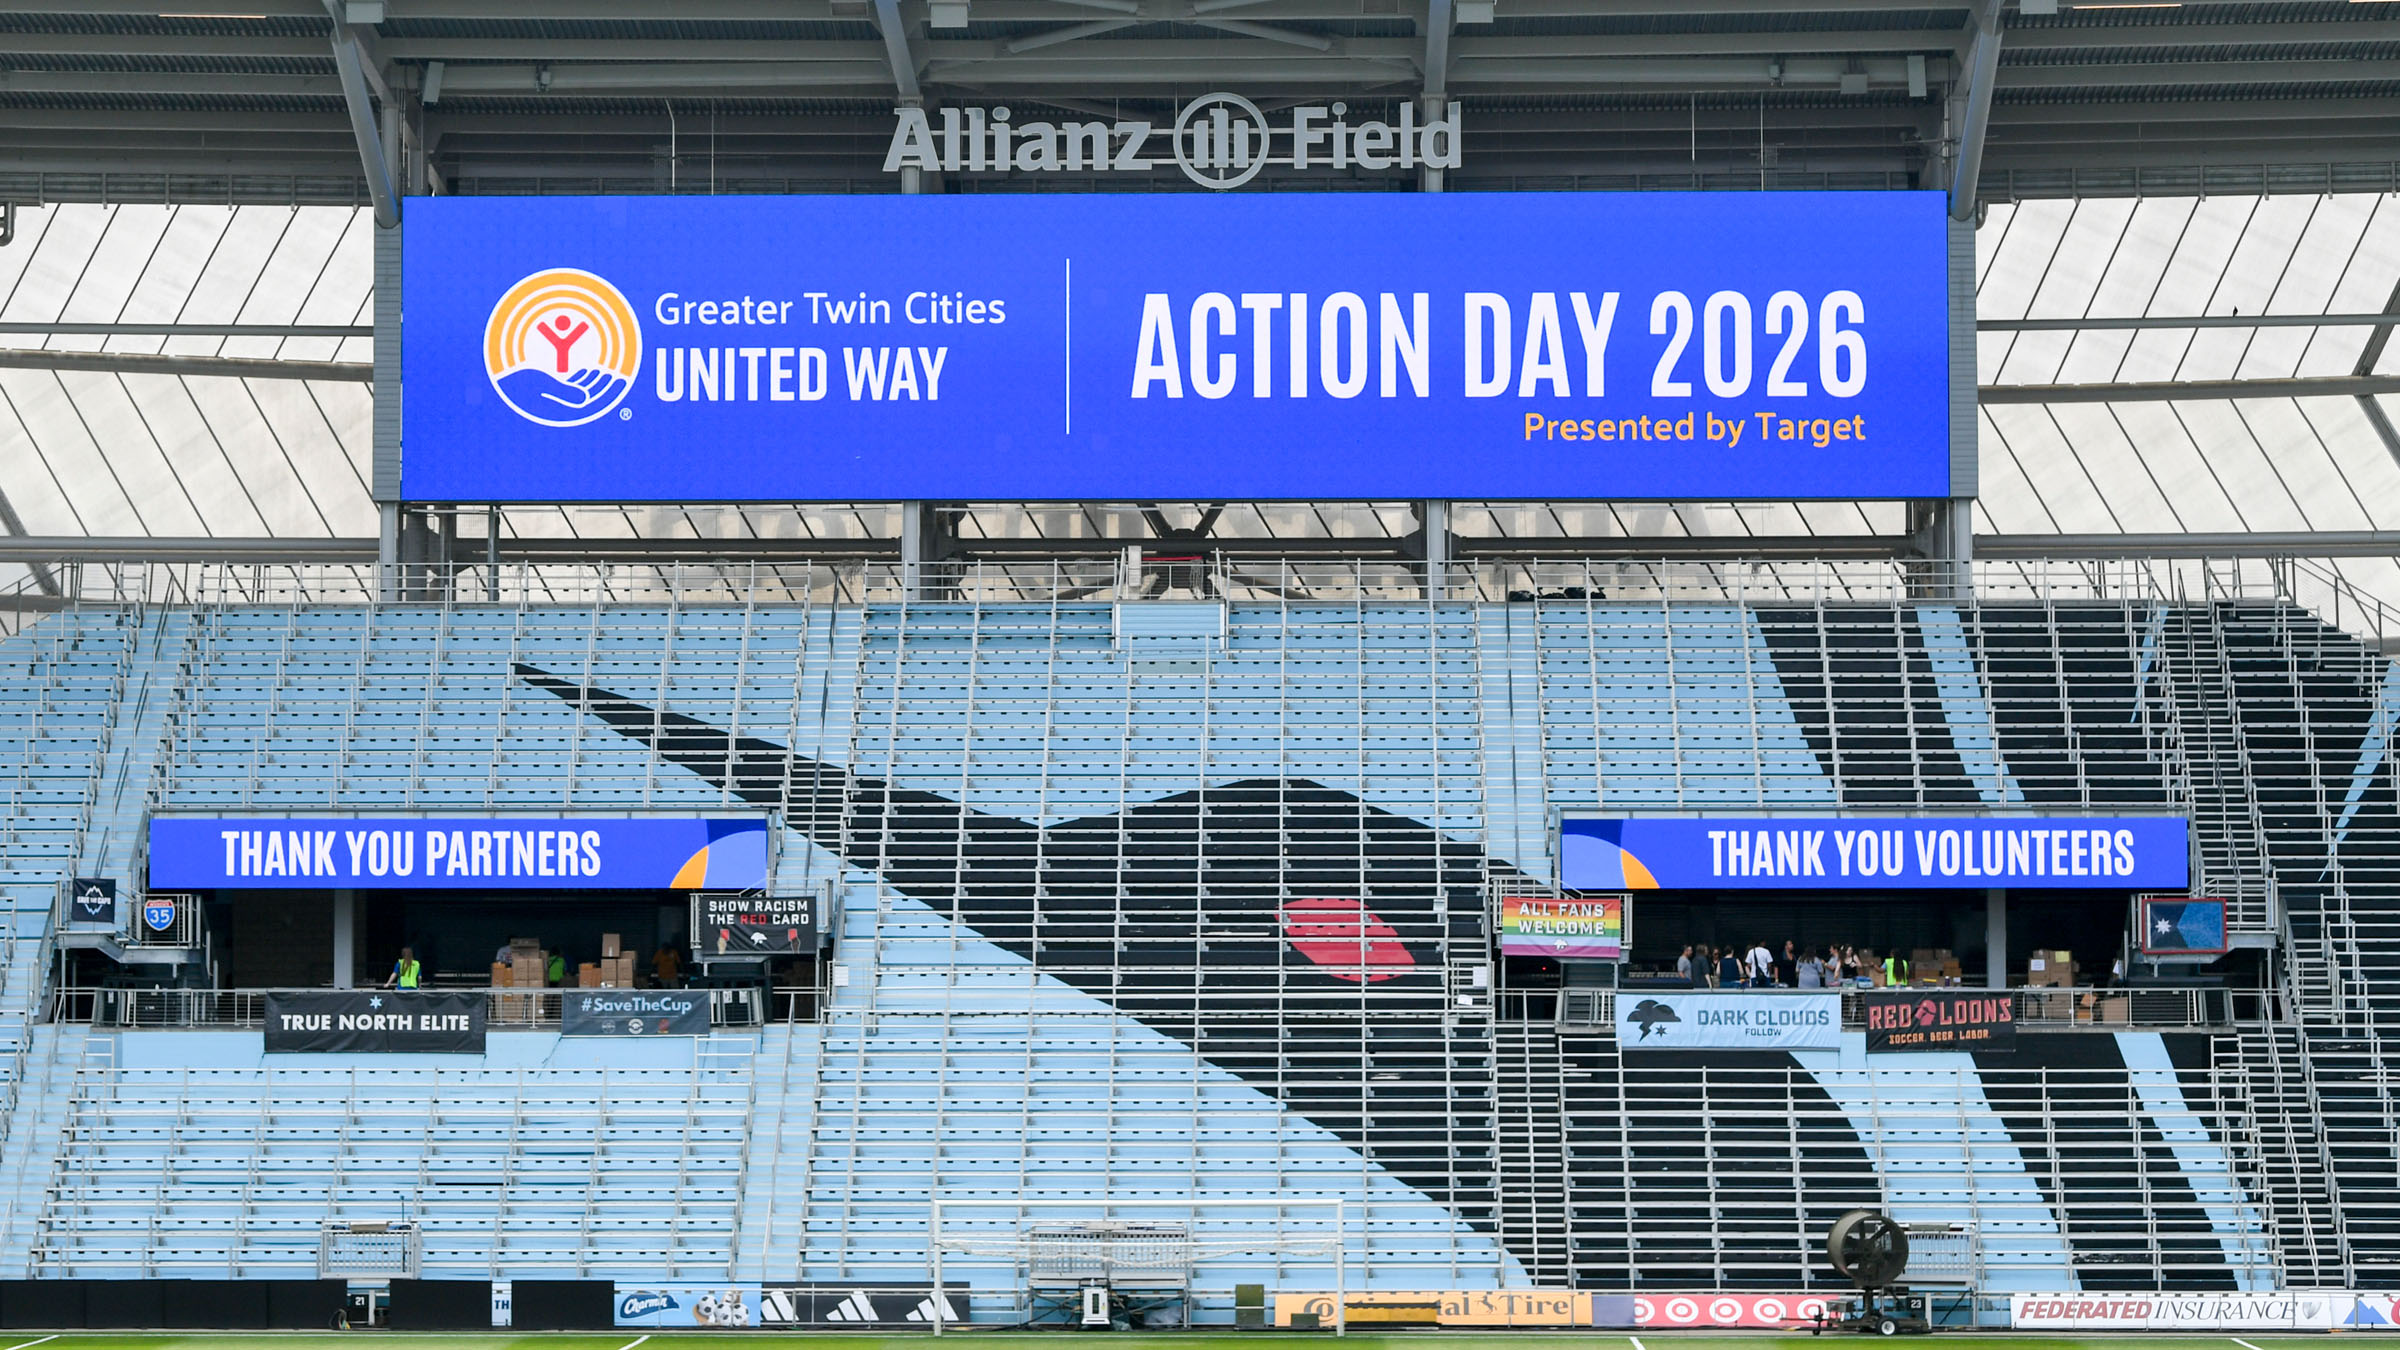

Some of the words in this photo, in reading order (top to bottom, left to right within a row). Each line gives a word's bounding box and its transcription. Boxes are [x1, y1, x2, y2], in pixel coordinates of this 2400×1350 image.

[882, 106, 1153, 172] Allianz
[1292, 100, 1462, 170] Field
[655, 291, 793, 326] Greater
[803, 291, 891, 324] Twin
[904, 291, 1006, 325] Cities
[1130, 291, 1430, 400] ACTION
[1464, 291, 1620, 398] DAY
[1649, 290, 1868, 398] 2026
[656, 347, 828, 402] UNITED
[842, 346, 948, 401] WAY
[1525, 411, 1695, 442] Presented
[1706, 411, 1746, 449] by
[1754, 412, 1866, 448] Target
[221, 830, 337, 877] THANK
[345, 830, 414, 877] YOU
[426, 829, 601, 877] PARTNERS
[1707, 829, 1826, 877] THANK
[1833, 829, 1904, 877] YOU
[1914, 829, 2135, 877] VOLUNTEERS
[708, 900, 750, 912] SHOW
[754, 900, 808, 912] RACISM
[1519, 902, 1552, 917] ALL
[1558, 903, 1605, 918] FANS
[150, 909, 170, 924] 35
[708, 914, 735, 925] THE
[740, 914, 767, 925] RED
[772, 914, 809, 925] CARD
[1518, 920, 1605, 935] WELCOME
[581, 997, 692, 1014] #SaveTheCup
[1869, 1004, 1912, 1030] RED
[1939, 998, 2012, 1026] LOONS
[280, 1014, 332, 1031] TRUE
[338, 1014, 413, 1031] NORTH
[420, 1014, 469, 1031] ELITE
[1697, 1010, 1748, 1026] DARK
[1755, 1010, 1829, 1026] CLOUDS
[1745, 1028, 1782, 1037] FOLLOW
[1888, 1033, 1927, 1045] SOCCER.
[1959, 1029, 1991, 1040] LABOR.
[355, 1296, 365, 1306] 21
[1498, 1294, 1570, 1316] Tire
[1910, 1299, 1922, 1309] 23
[2019, 1300, 2153, 1320] FEDERATED
[2154, 1300, 2299, 1320] INSURANCE
